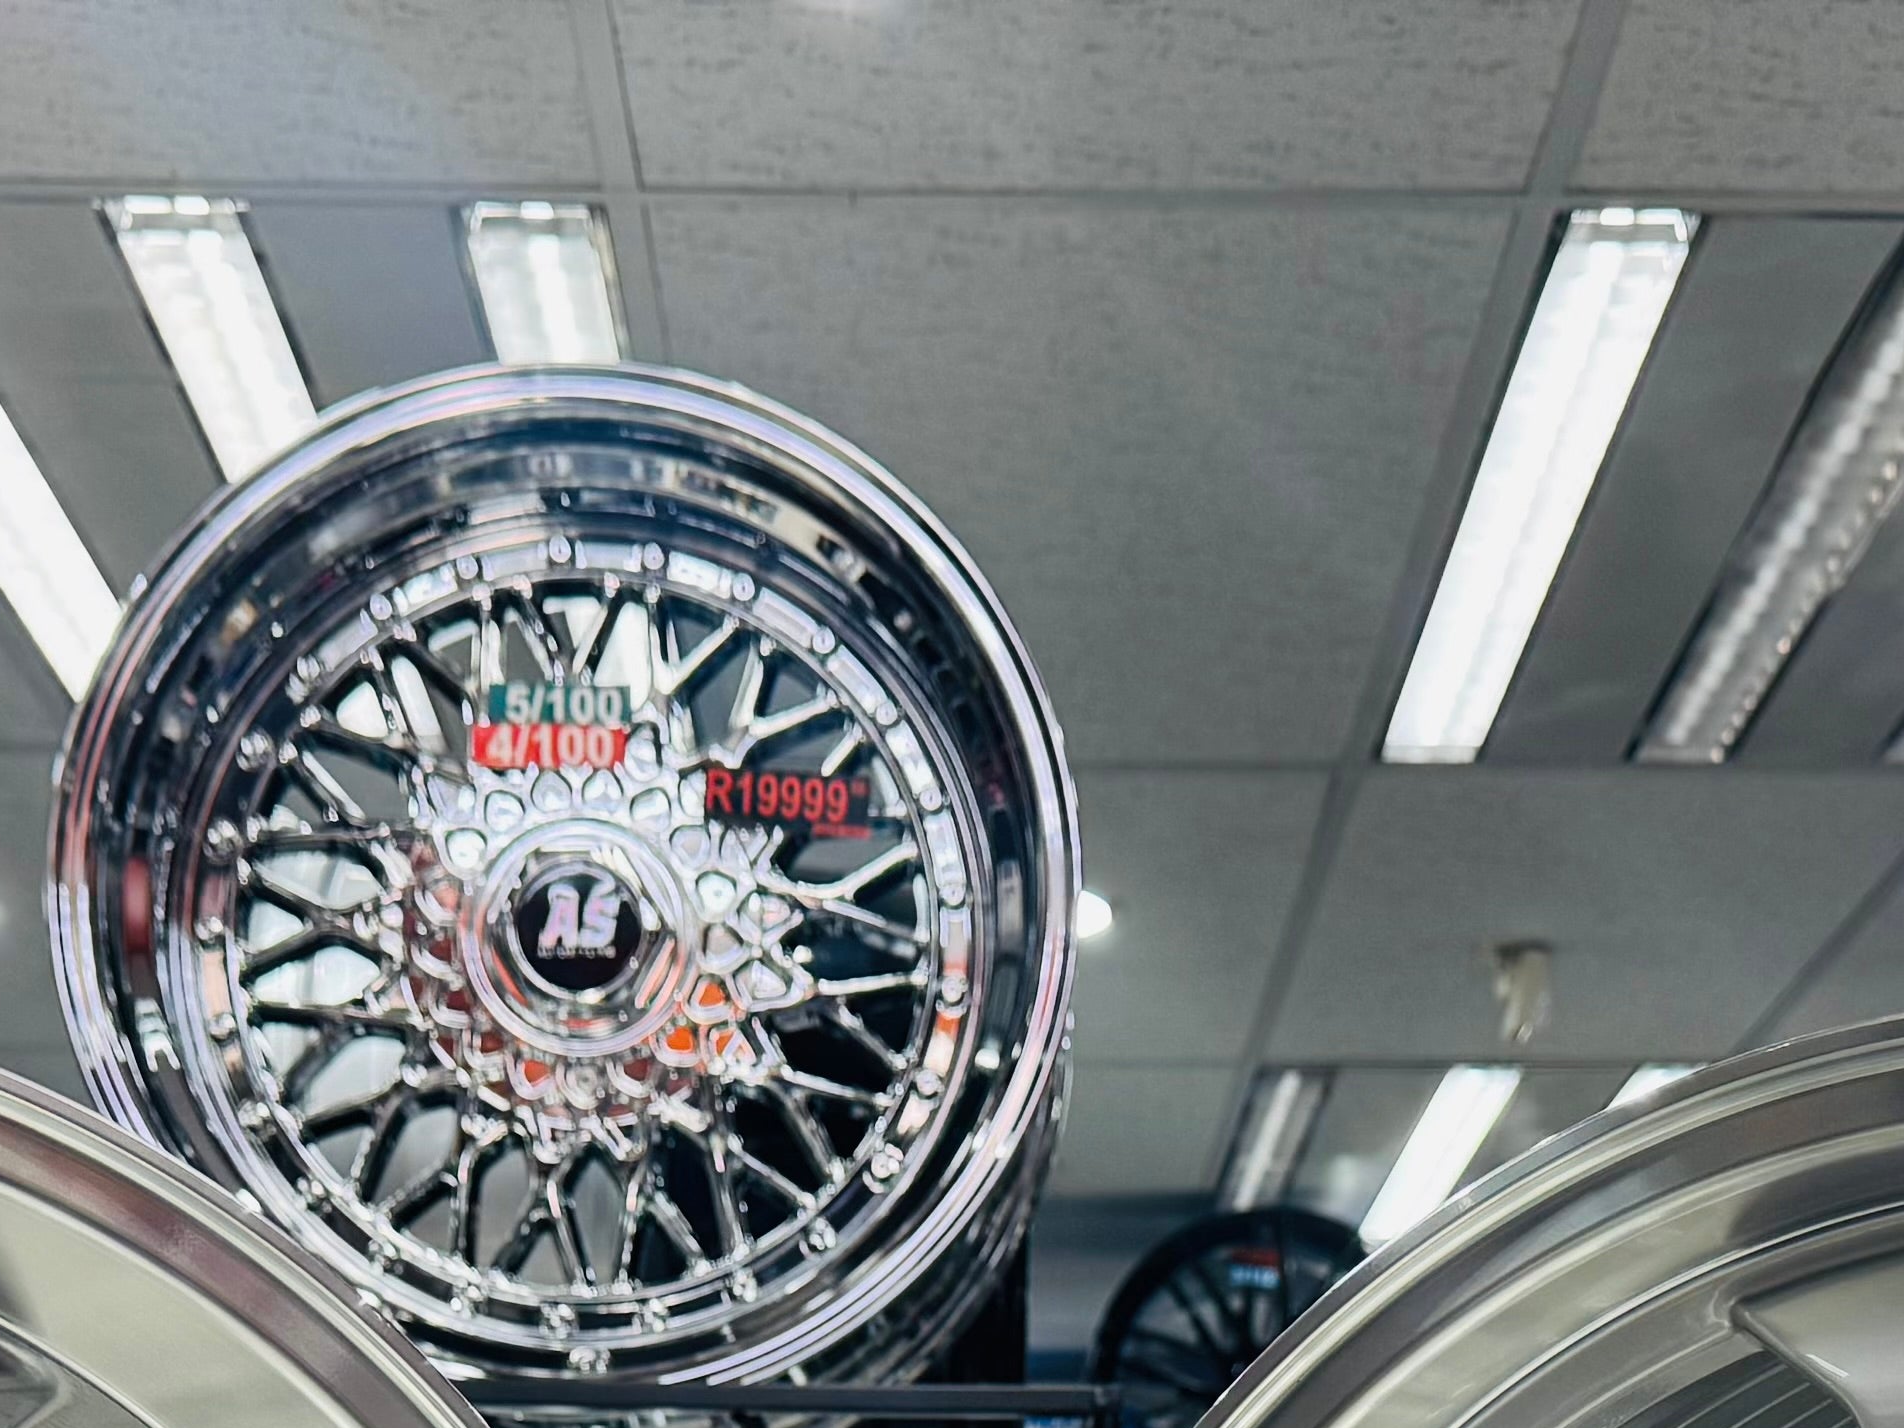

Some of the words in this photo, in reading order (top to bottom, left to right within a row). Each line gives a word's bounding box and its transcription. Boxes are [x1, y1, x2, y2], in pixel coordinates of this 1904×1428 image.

[505, 682, 623, 723] 5/100
[486, 724, 614, 767] 4/100
[706, 768, 849, 822] R19999
